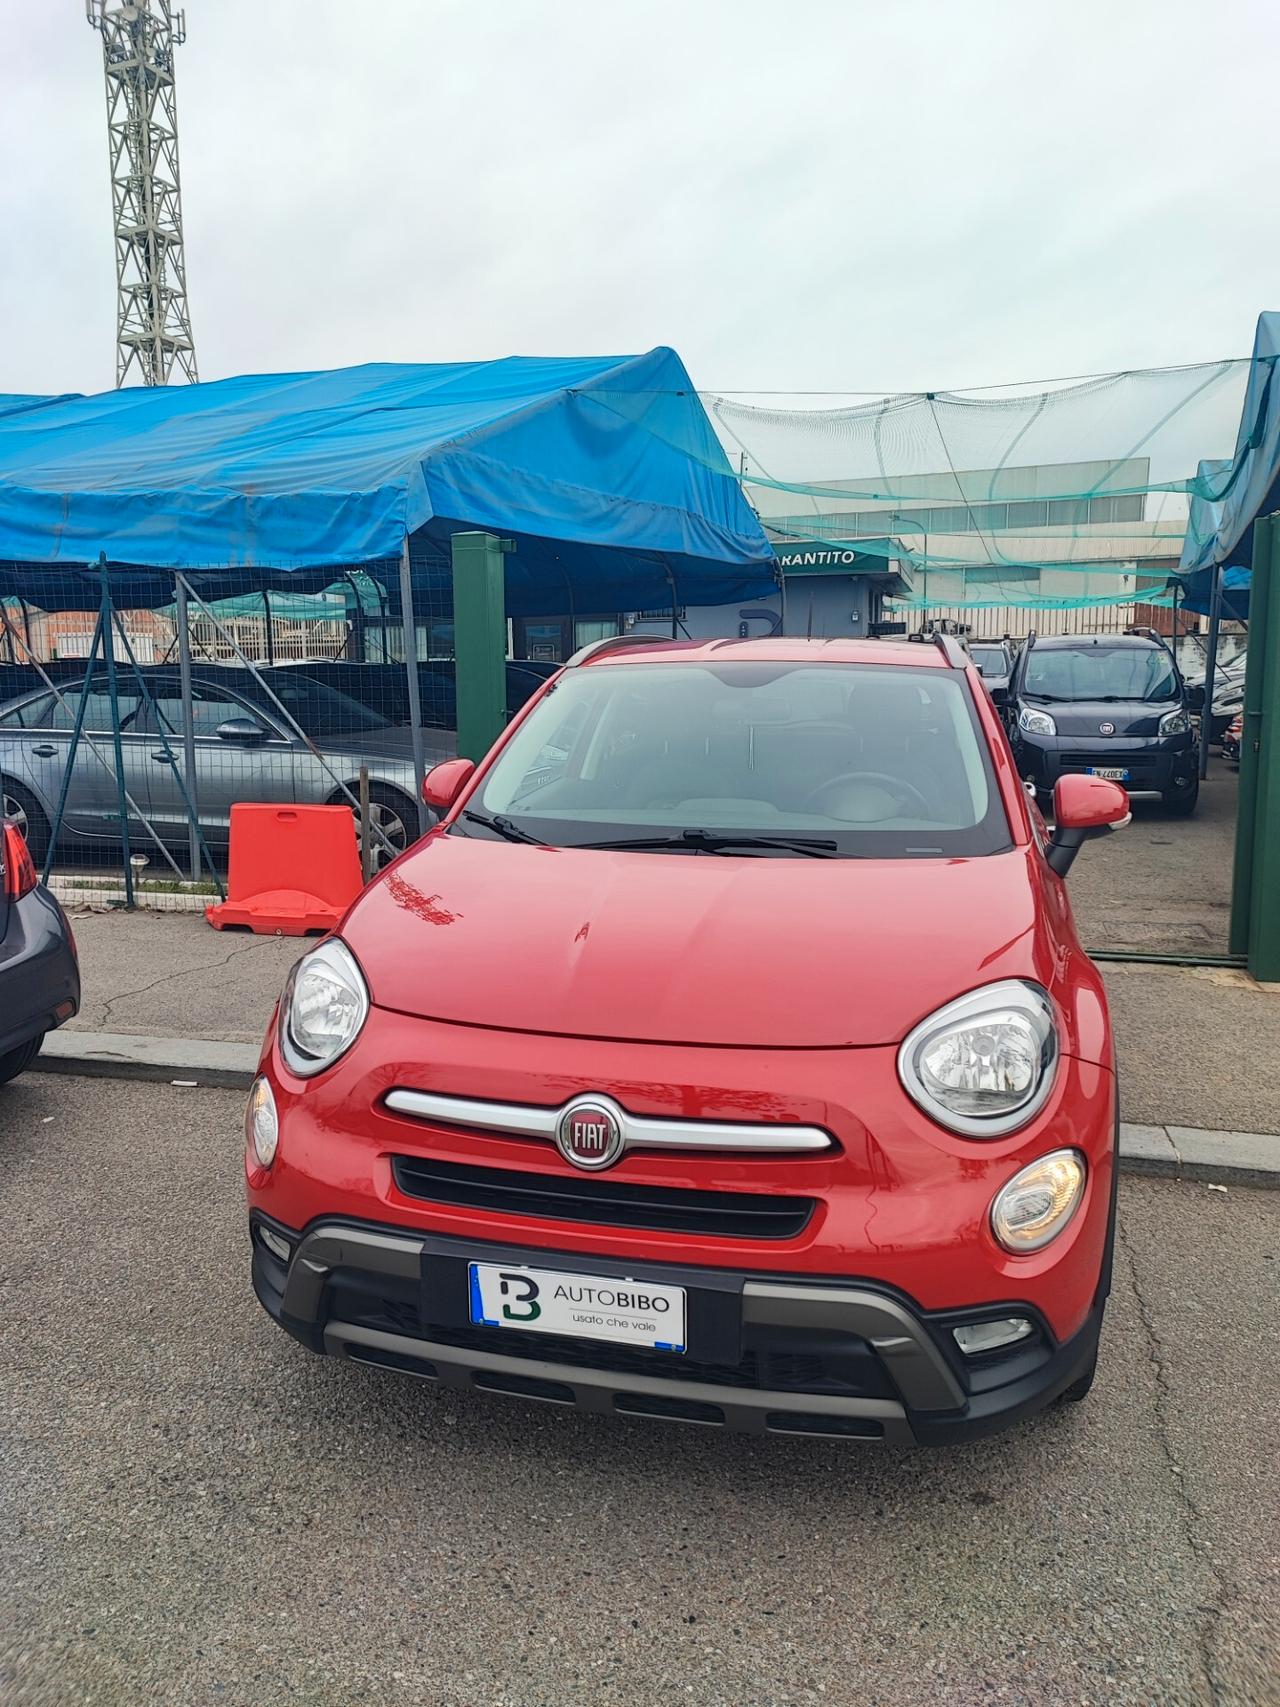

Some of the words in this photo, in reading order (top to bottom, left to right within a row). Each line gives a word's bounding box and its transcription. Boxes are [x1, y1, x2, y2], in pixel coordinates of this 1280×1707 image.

[574, 1122, 607, 1150] FIAT
[553, 1285, 670, 1313] AUTOBIBO
[572, 1313, 603, 1326] usato
[606, 1317, 629, 1329] che
[631, 1321, 657, 1332] vale
